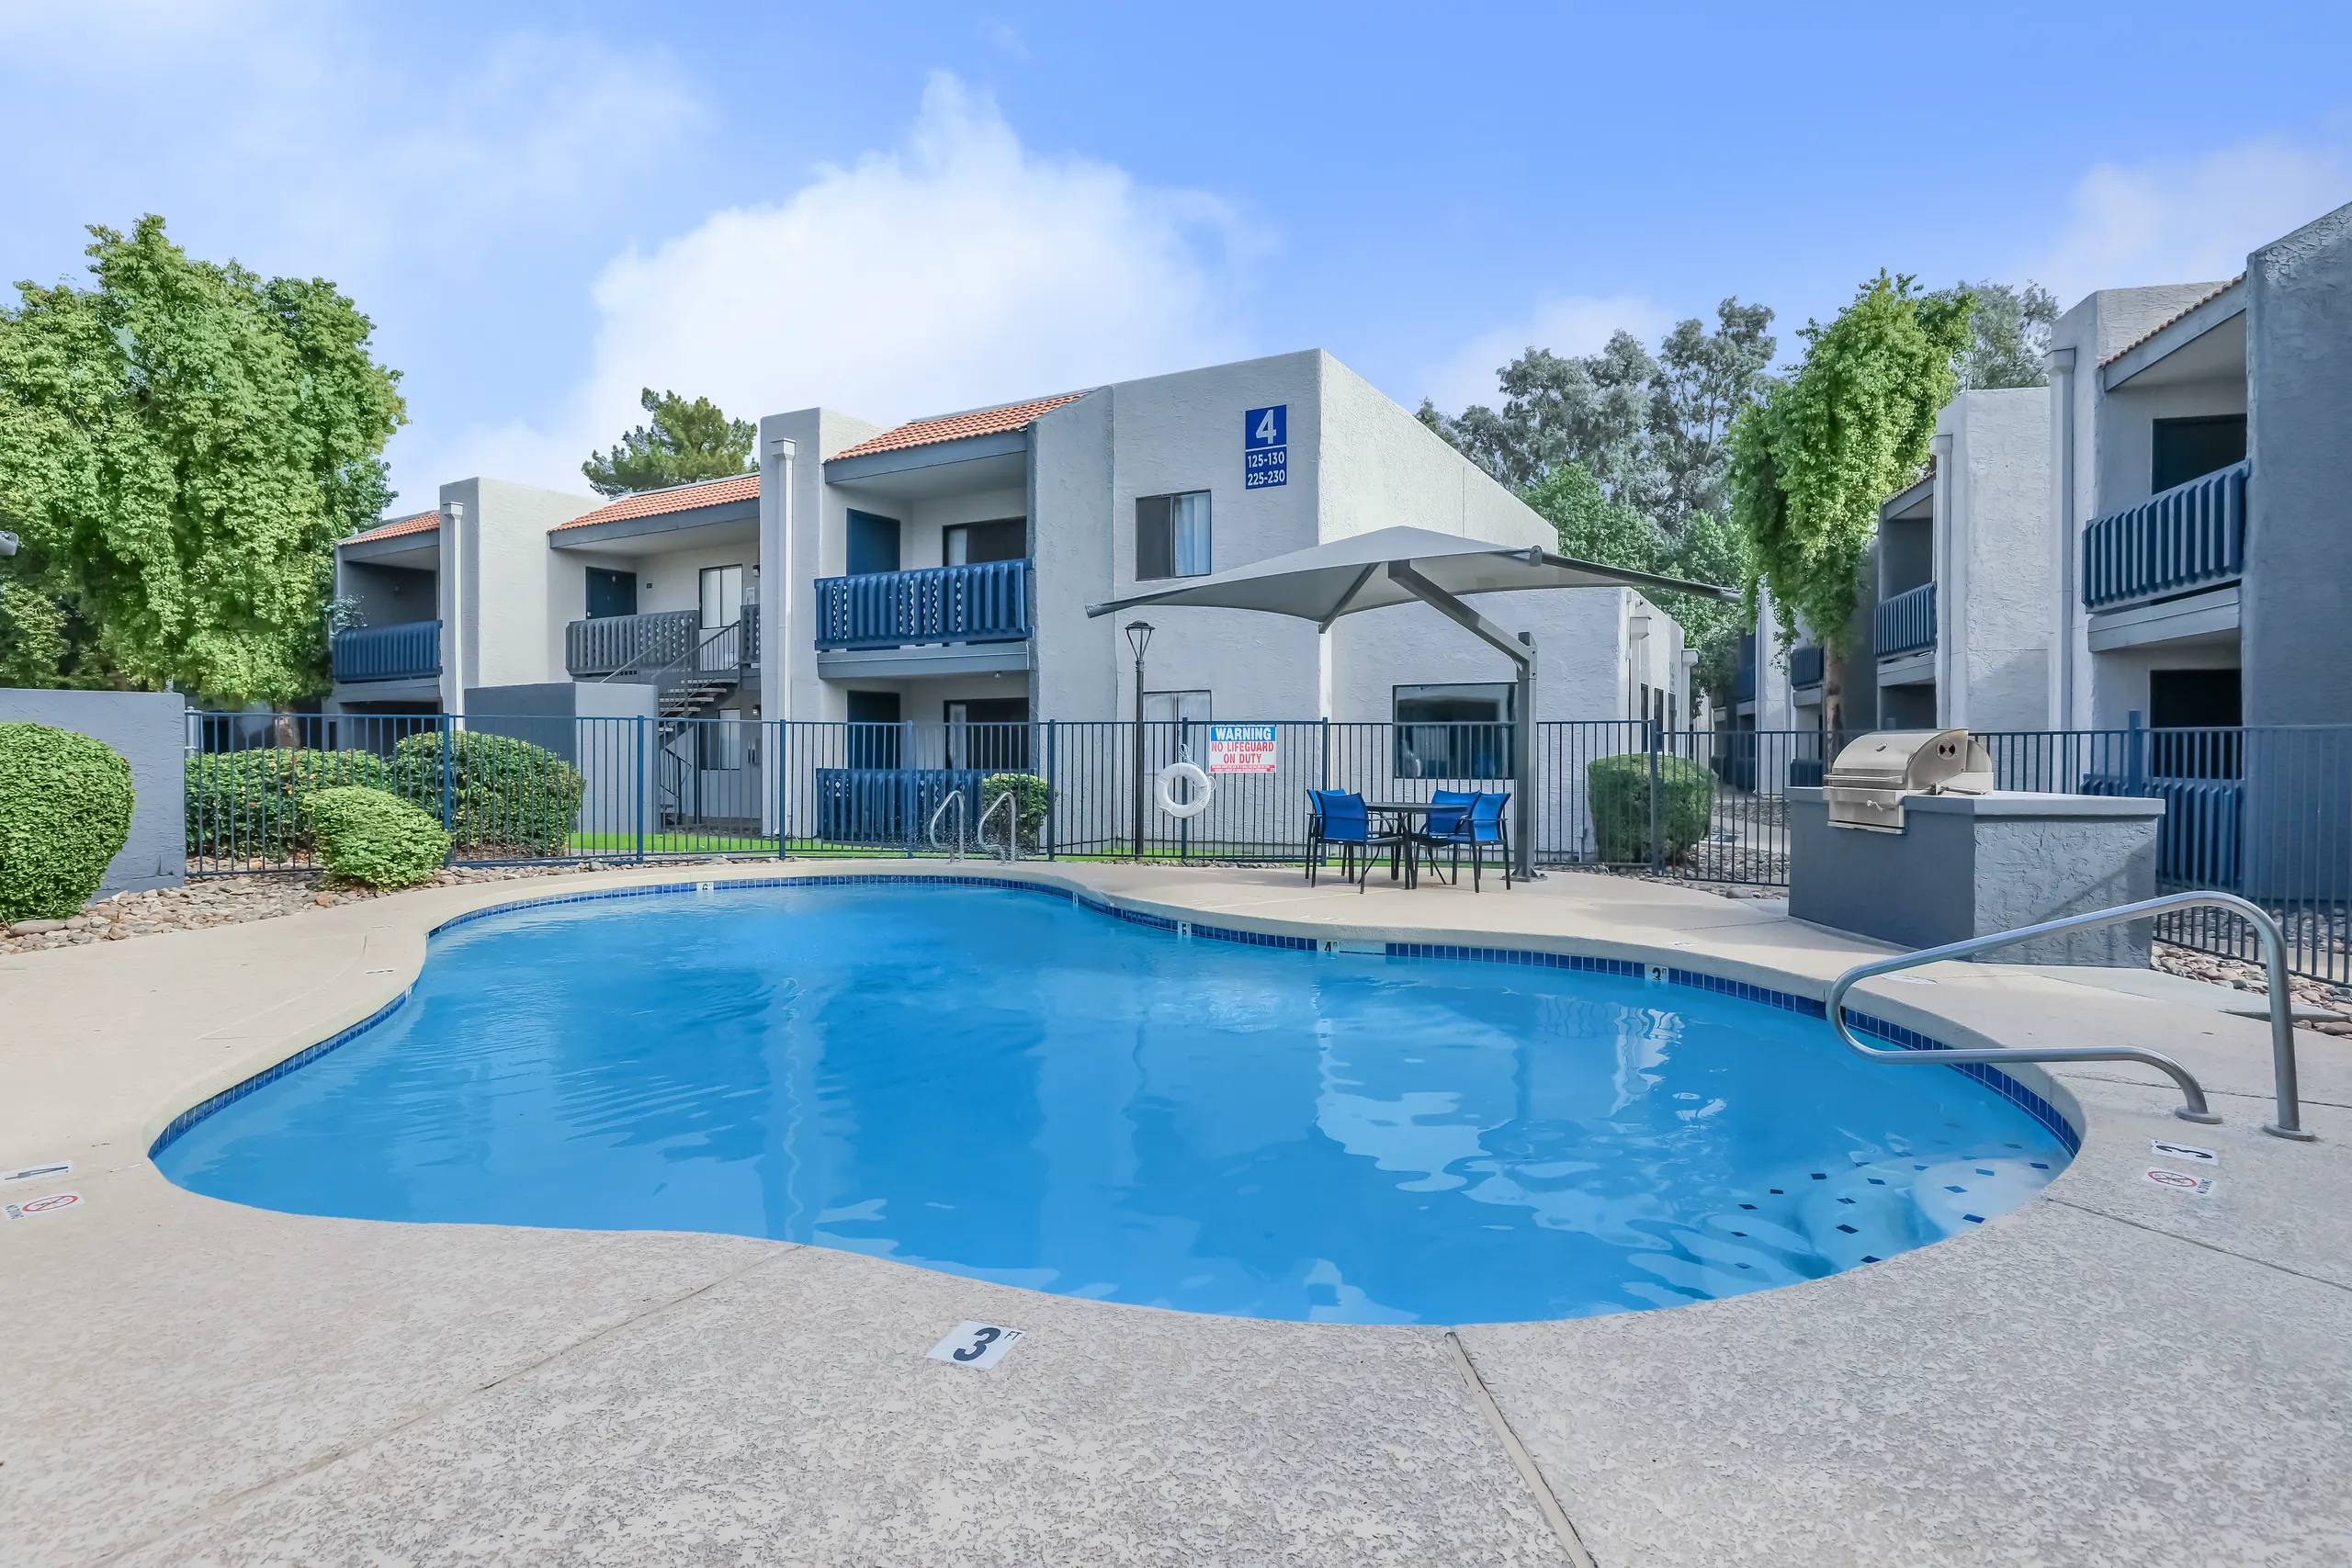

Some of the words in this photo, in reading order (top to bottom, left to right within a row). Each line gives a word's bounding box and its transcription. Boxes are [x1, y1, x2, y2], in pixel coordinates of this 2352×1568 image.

[1256, 409, 1276, 445] 4
[1248, 451, 1284, 468] 125-130
[1248, 469, 1285, 486] 225-230
[1216, 728, 1272, 741] WARNING
[1212, 742, 1224, 752] NO
[1227, 742, 1273, 752] LIFEGUARD
[1224, 753, 1235, 764] ON
[1239, 753, 1261, 764] DUTY
[1324, 941, 1331, 953] 4
[1652, 966, 1661, 981] 3
[2155, 1145, 2213, 1159] 3
[953, 1327, 1001, 1361] 3
[1004, 1330, 1023, 1341] FT
